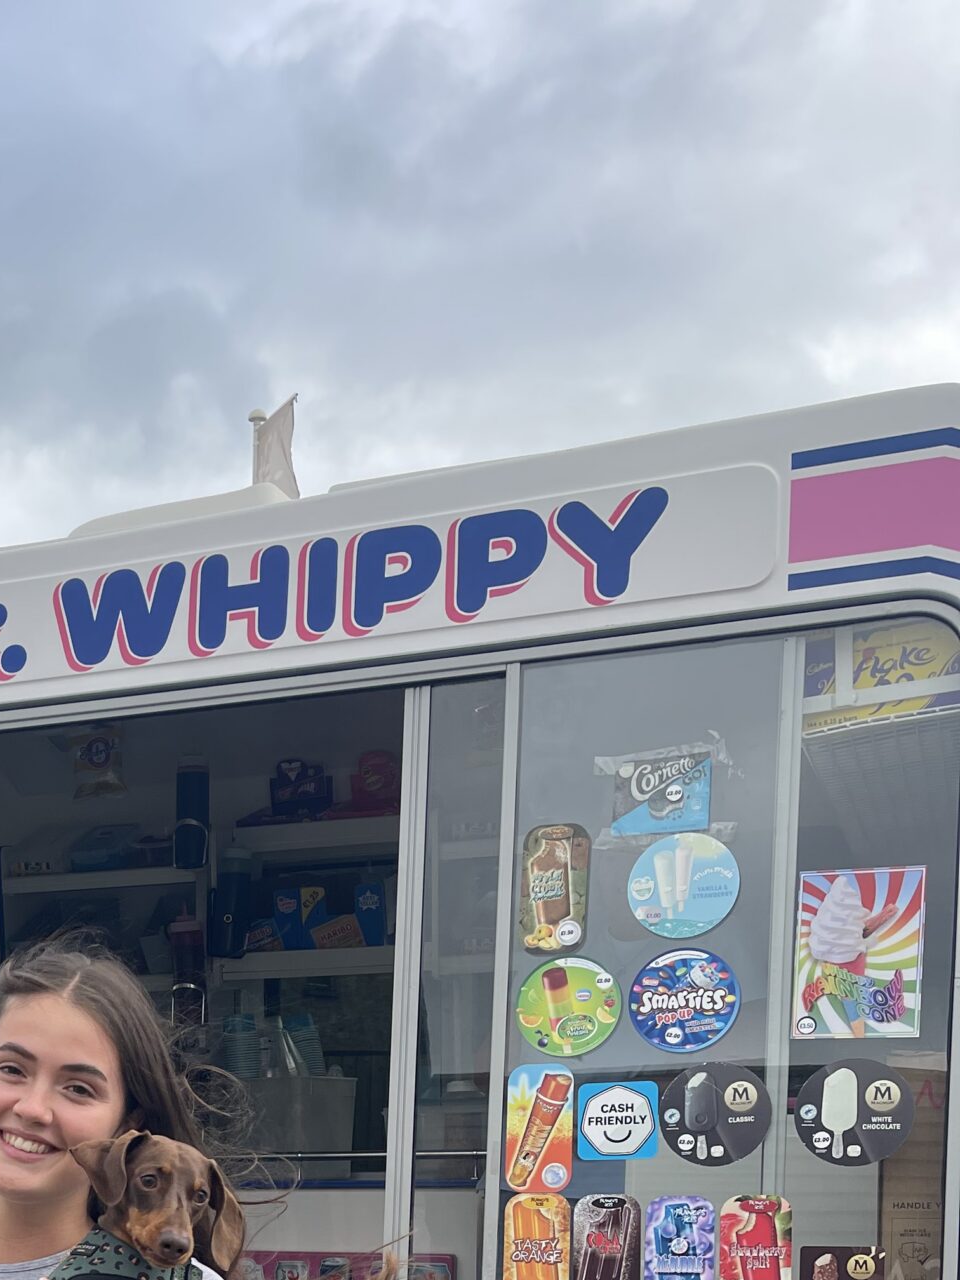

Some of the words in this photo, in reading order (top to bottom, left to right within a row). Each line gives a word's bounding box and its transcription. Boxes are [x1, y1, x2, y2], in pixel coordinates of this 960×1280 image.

[53, 485, 669, 673] WHIPPY
[631, 757, 695, 802] Cornetto
[320, 923, 352, 943] HARIBO
[802, 968, 904, 1013] RAINBOW
[639, 987, 727, 1014] SMARTIES
[656, 1013, 677, 1024] POP
[678, 1008, 693, 1019] UP
[856, 995, 905, 1023] CONE
[732, 1087, 750, 1101] M
[874, 1086, 892, 1101] M
[600, 1103, 634, 1113] CASH
[587, 1114, 647, 1126] FRIENDLY
[727, 1115, 755, 1123] CLASSIC
[892, 1201, 931, 1210] HANDLE
[513, 1239, 559, 1251] TASTY
[730, 1242, 787, 1259] Strawberry
[511, 1250, 563, 1264] ORANGE
[746, 1256, 770, 1270] Split
[853, 1258, 869, 1272] M
